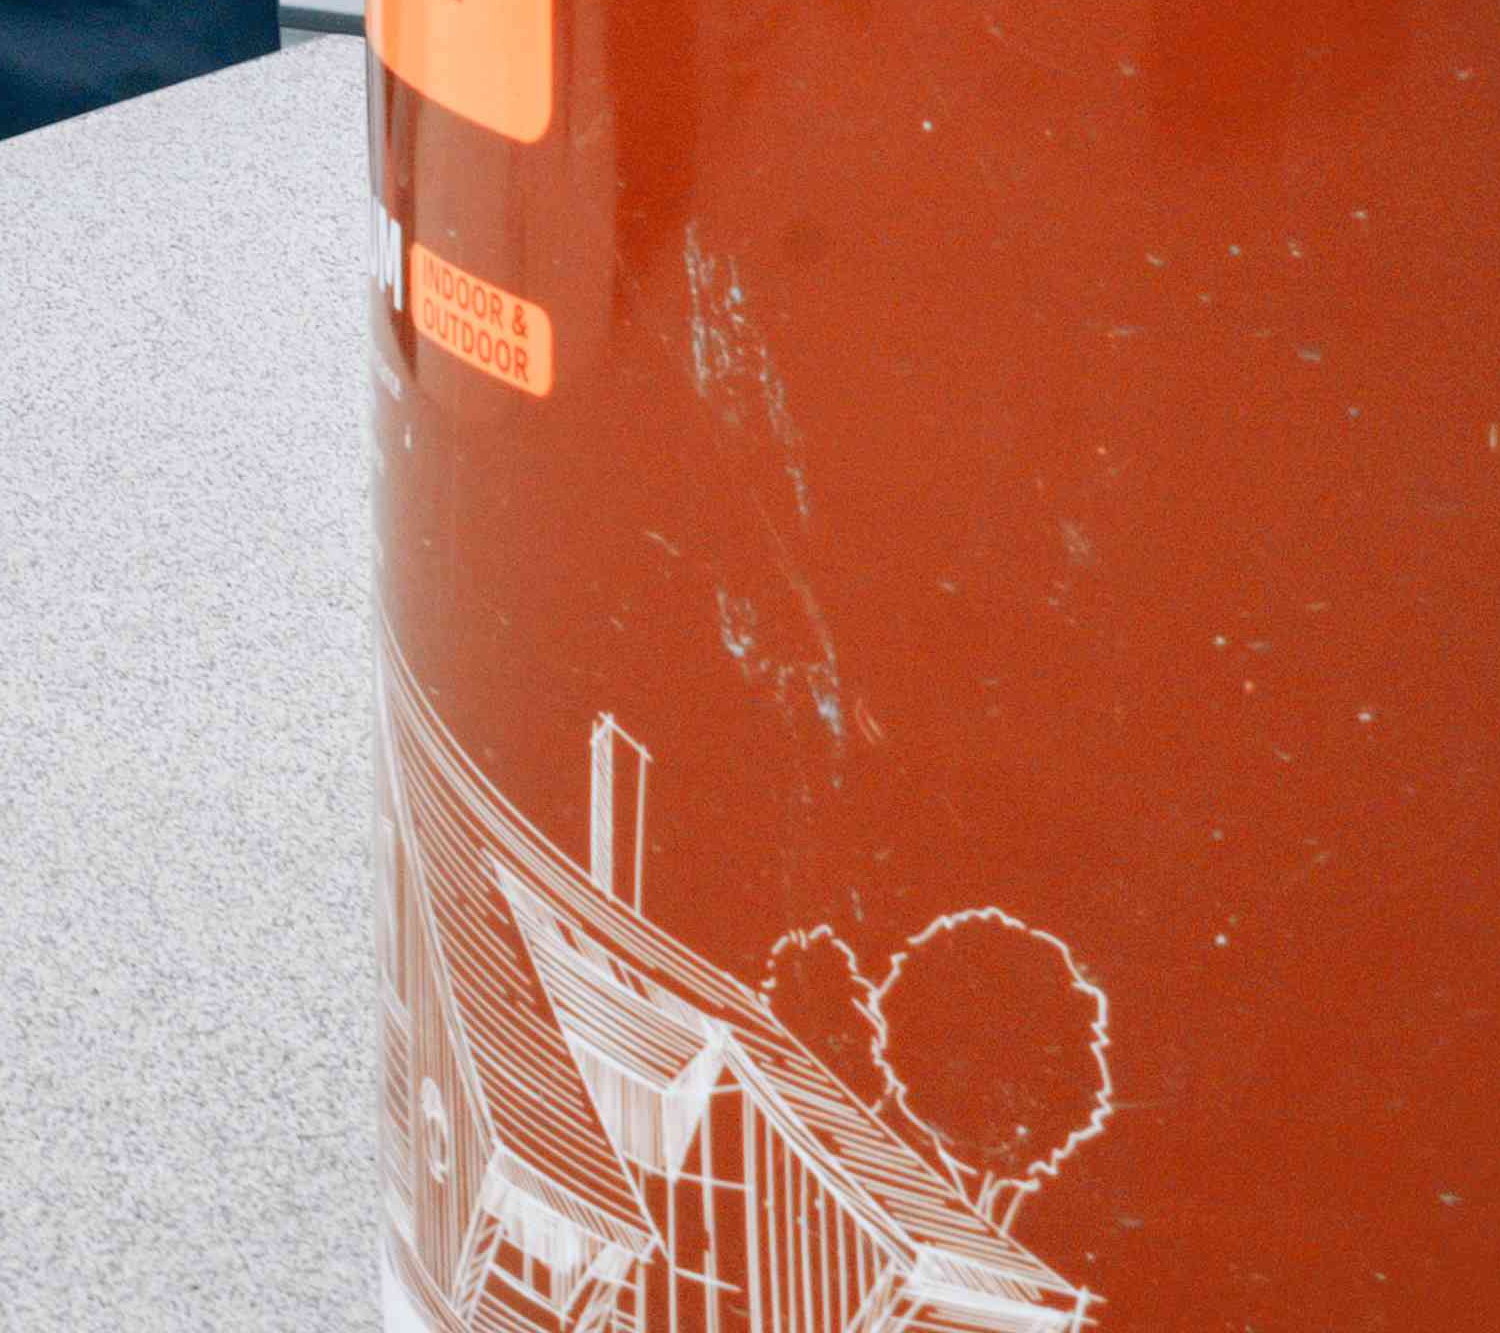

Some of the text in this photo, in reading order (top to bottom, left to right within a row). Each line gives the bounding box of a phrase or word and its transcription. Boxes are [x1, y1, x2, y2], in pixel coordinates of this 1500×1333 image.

[422, 253, 529, 340] INDOOR &
[422, 297, 529, 384] OUTDOOR
